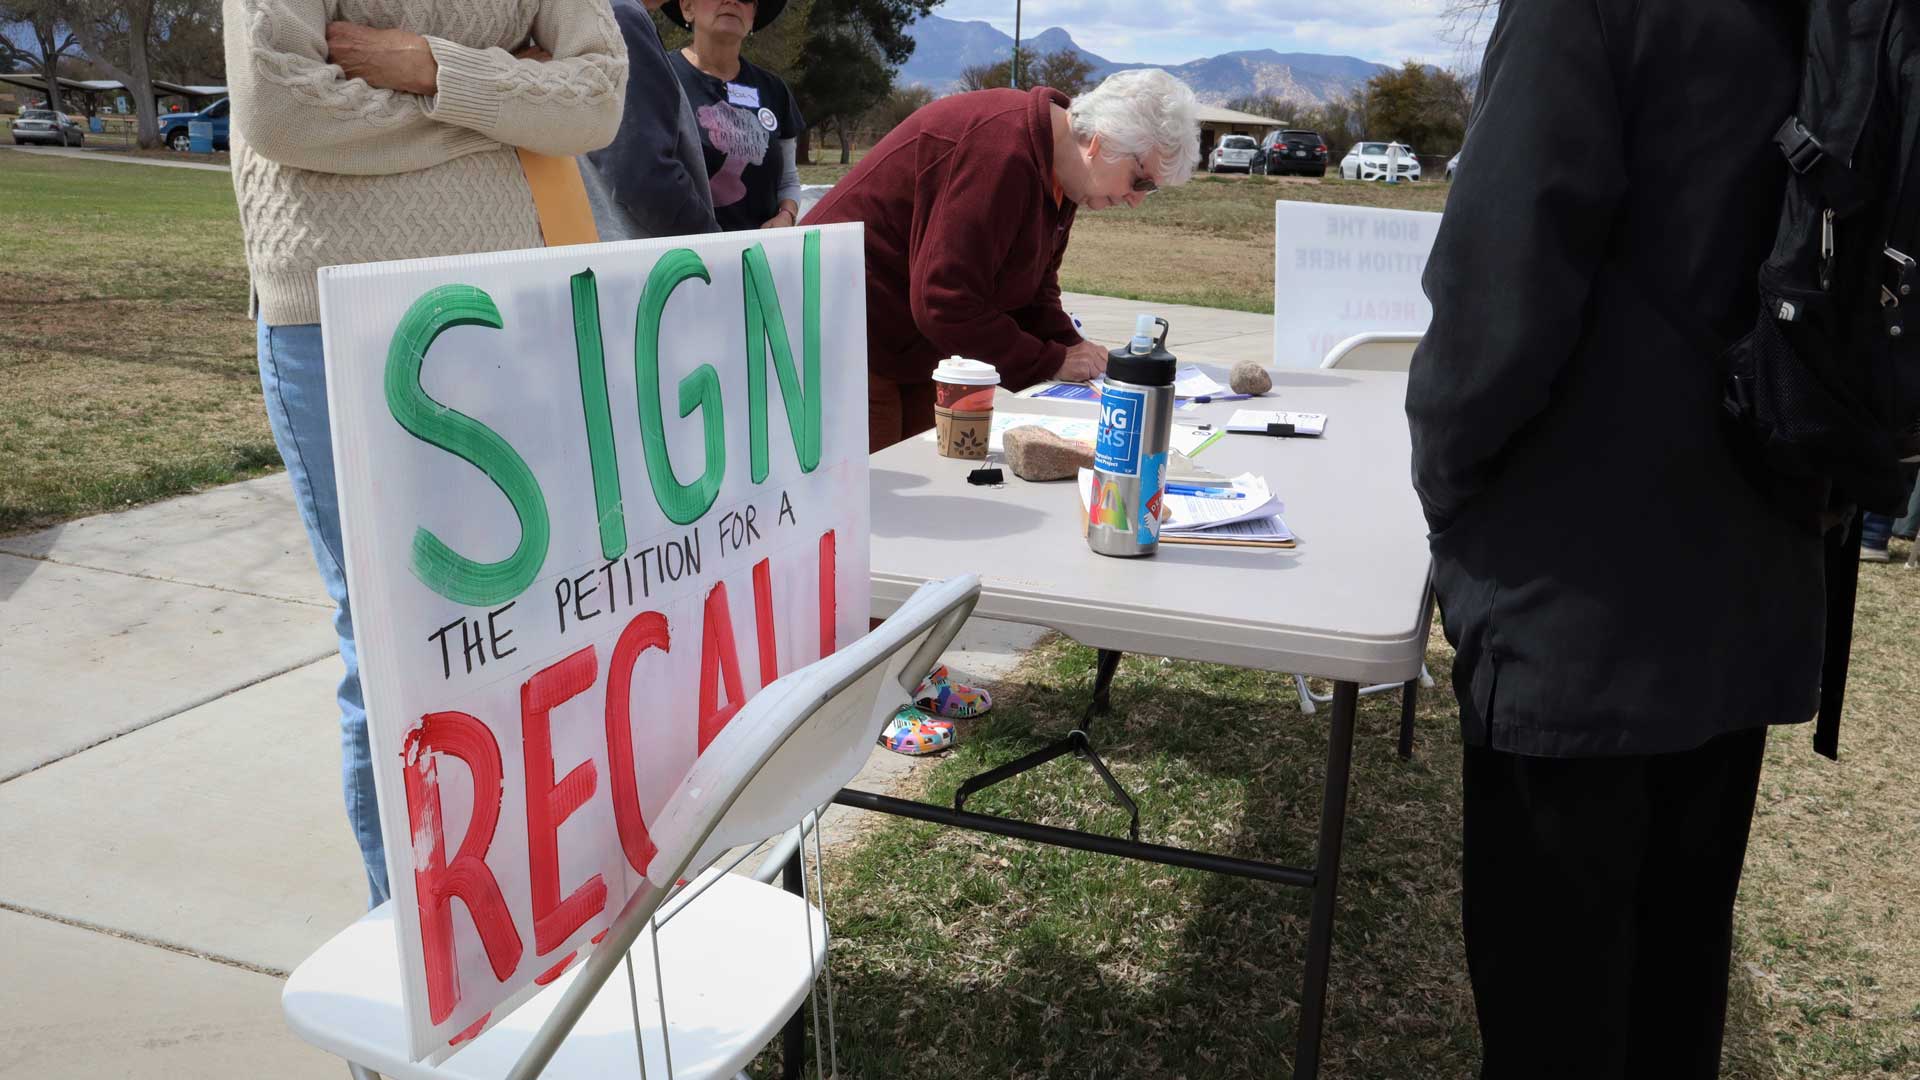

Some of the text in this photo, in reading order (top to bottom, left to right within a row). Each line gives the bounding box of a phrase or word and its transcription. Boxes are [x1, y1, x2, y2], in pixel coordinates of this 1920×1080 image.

[384, 229, 821, 607] SIGN
[1097, 429, 1125, 448] ERS
[1098, 406, 1127, 430] NG
[429, 490, 796, 679] THE PETITION FOR A
